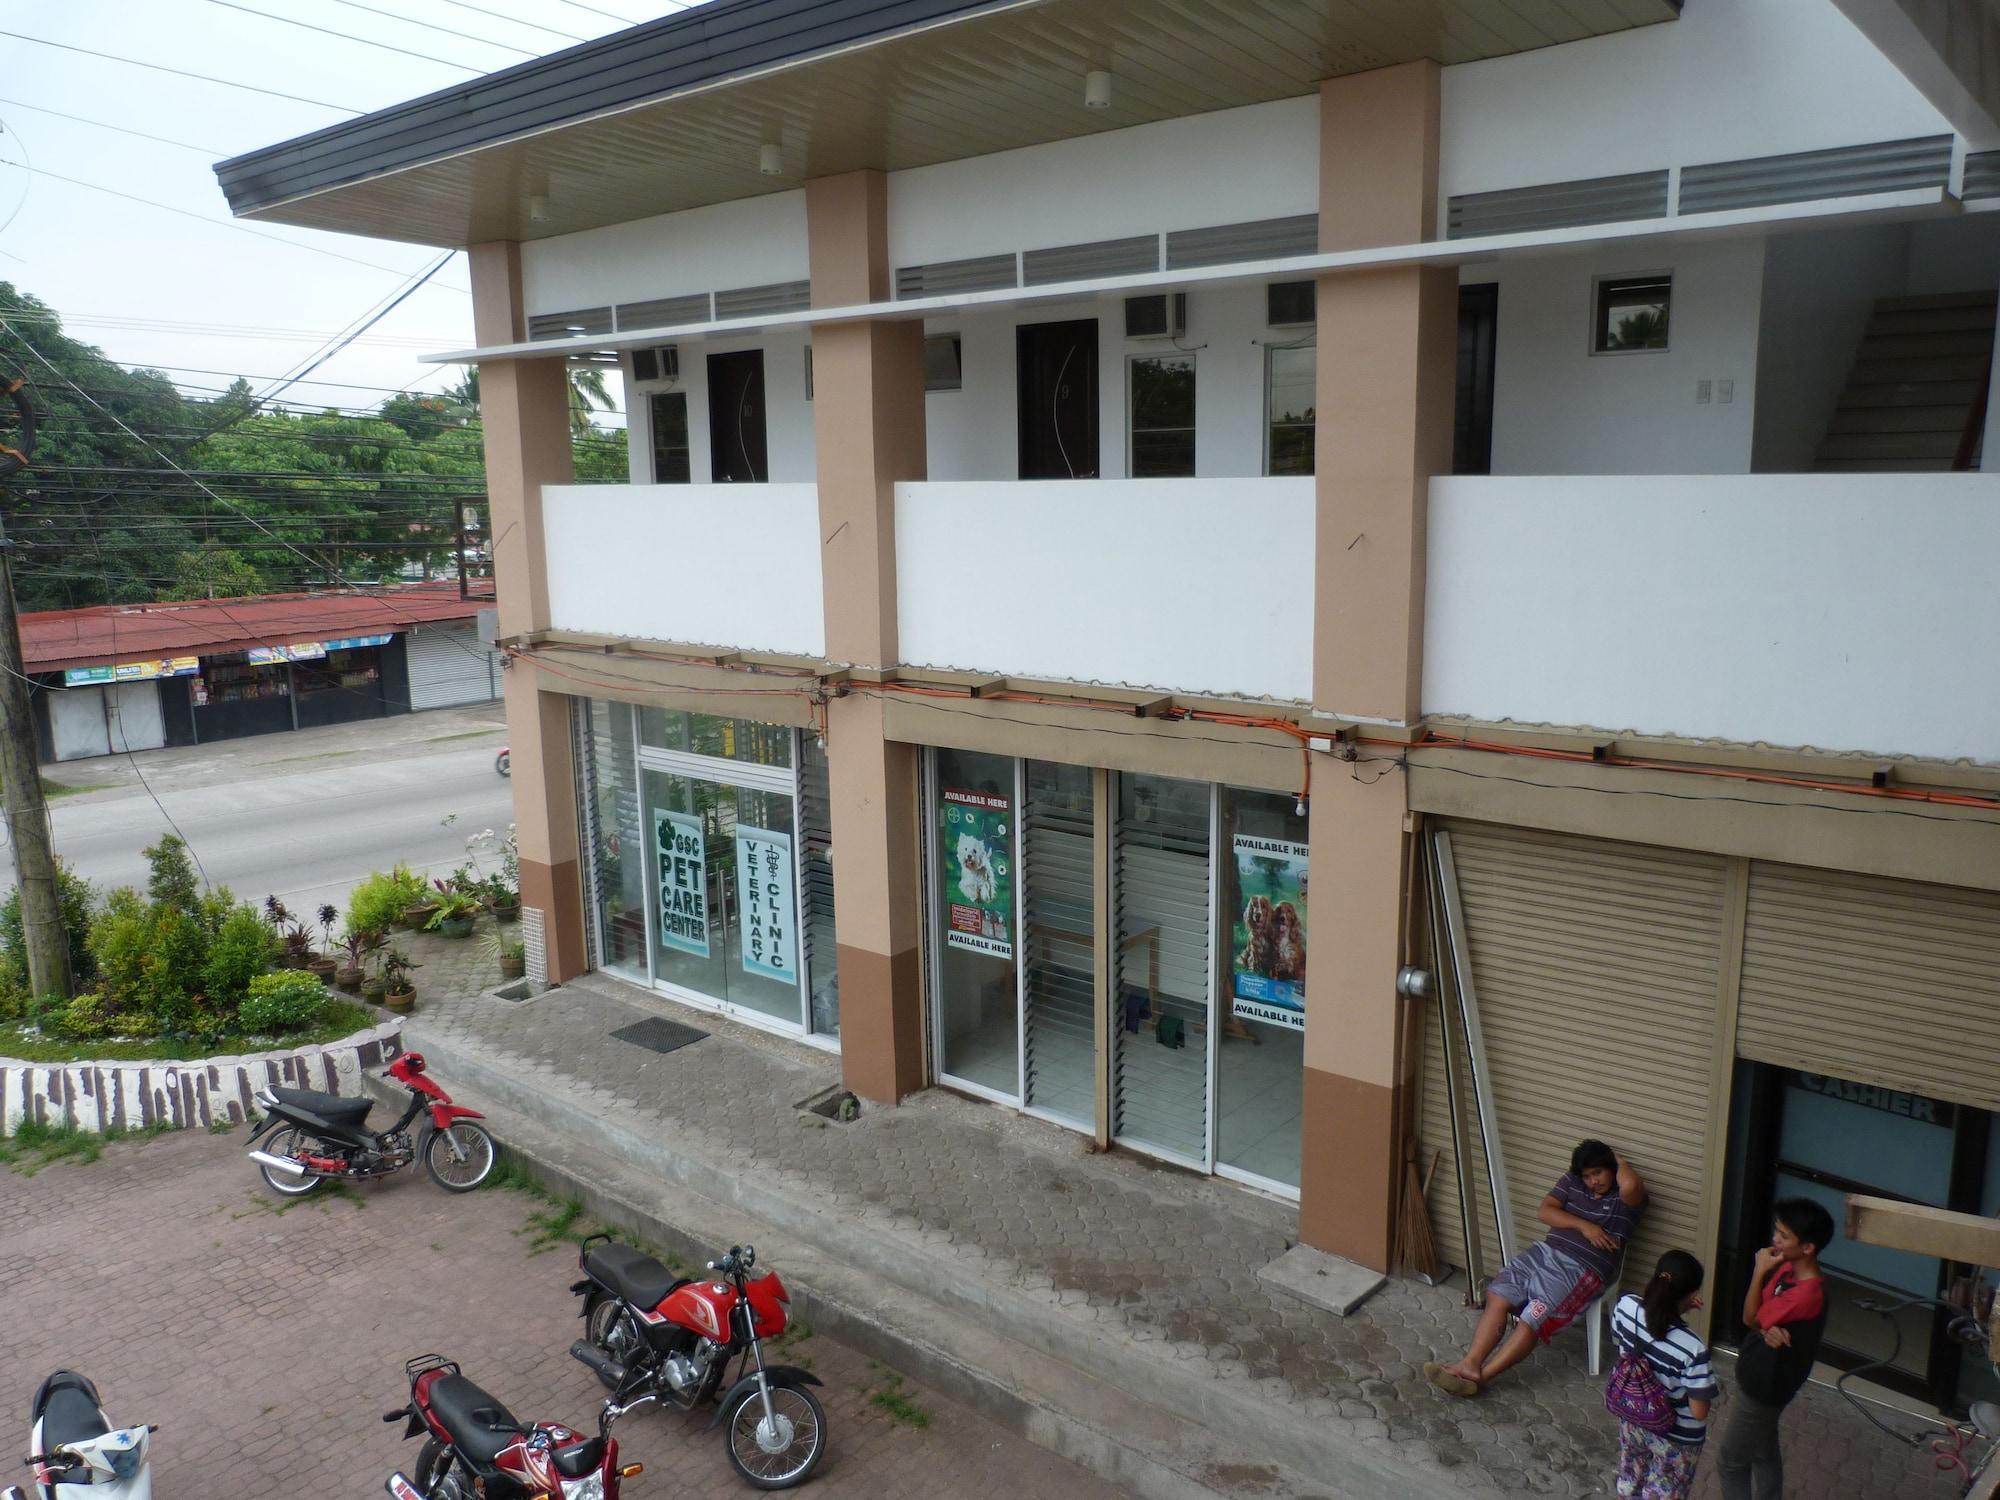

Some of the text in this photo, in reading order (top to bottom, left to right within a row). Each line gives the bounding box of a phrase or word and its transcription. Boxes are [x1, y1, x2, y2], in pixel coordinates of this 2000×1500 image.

[944, 791, 1008, 809] AVAILABLE HERE
[676, 834, 700, 857] GSC
[1235, 838, 1309, 857] AVAILABLE HE
[659, 853, 702, 891] PET
[661, 886, 704, 918] CARE
[745, 840, 763, 962] VETERINARY
[663, 912, 706, 943] CENTER
[767, 883, 784, 968] CLINIC
[949, 934, 1012, 955] AVAILABLE HERE
[1235, 1003, 1305, 1027] AVAILABLE HE
[1801, 1072, 1936, 1122] CASHIER
